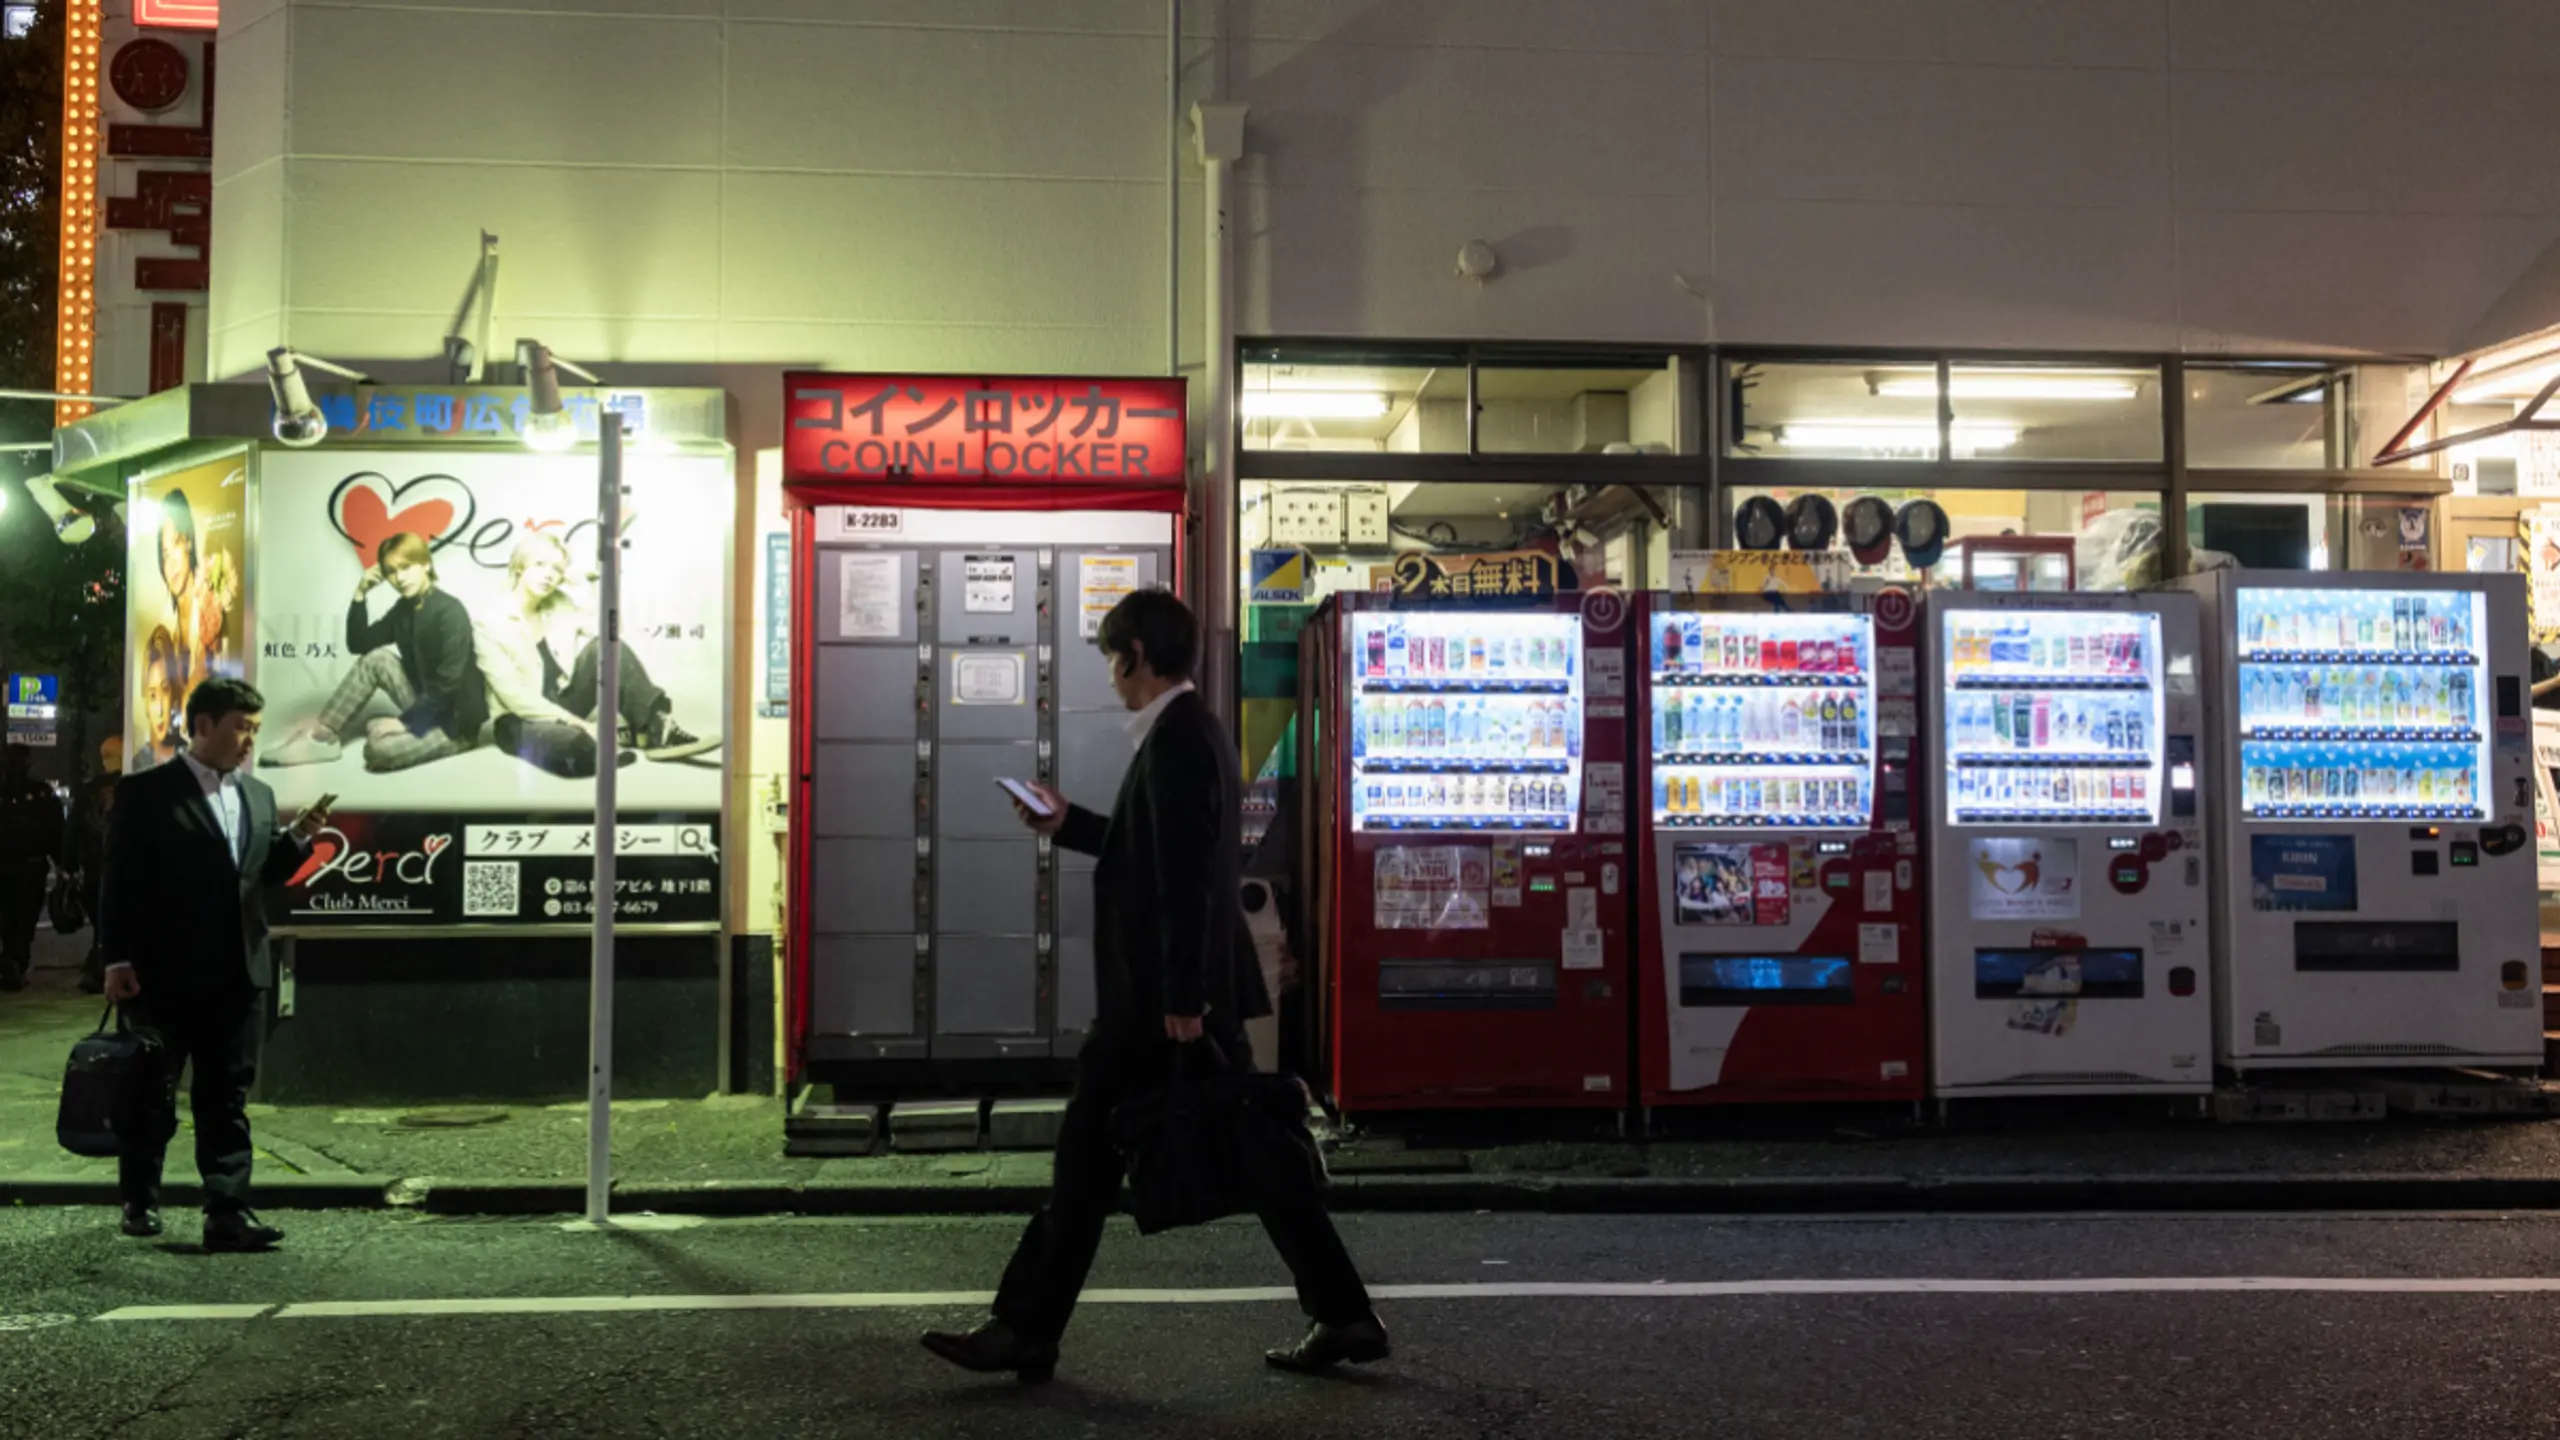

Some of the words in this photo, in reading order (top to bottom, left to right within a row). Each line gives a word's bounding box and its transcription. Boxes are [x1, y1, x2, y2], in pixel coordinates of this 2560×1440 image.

[793, 384, 1179, 438] コインロッカー
[819, 439, 1152, 477] COIN-LOCKER
[846, 513, 898, 529] K-2283
[1254, 590, 1301, 601] ALSOK
[481, 829, 549, 852] クラブ
[572, 830, 662, 850] メシー
[308, 891, 354, 910] Club
[358, 893, 409, 910] Merci
